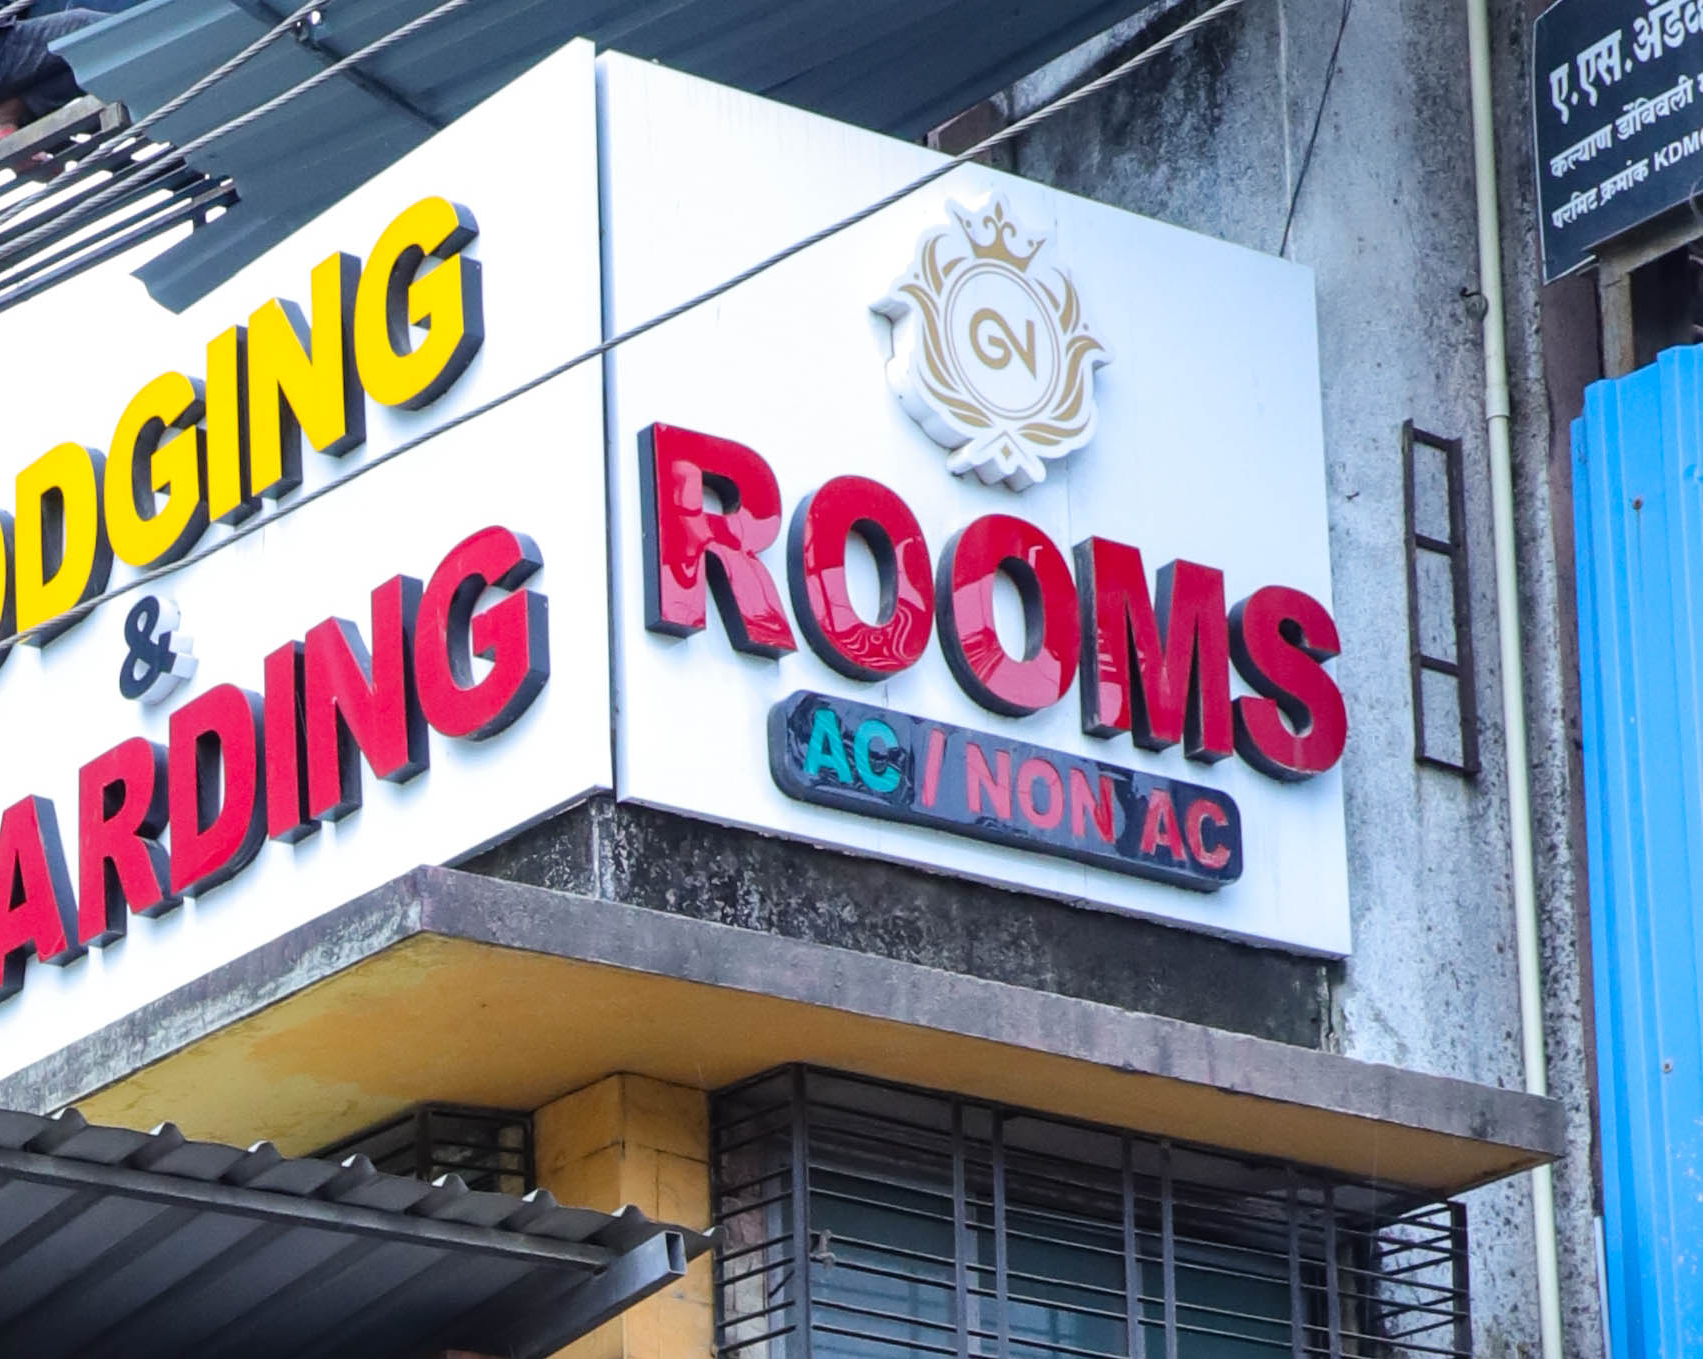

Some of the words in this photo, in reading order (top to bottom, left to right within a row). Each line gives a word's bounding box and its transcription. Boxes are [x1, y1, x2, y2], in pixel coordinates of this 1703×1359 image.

[1550, 124, 1613, 178] कल्याण
[1551, 188, 1599, 229] परमिट
[1599, 160, 1649, 207] क्रमांक
[1653, 128, 1703, 172] KDM
[119, 595, 198, 706] &
[638, 422, 1348, 783] ROOMS
[802, 708, 901, 794] AC
[965, 741, 1116, 843] NON
[1140, 788, 1233, 871] AC
